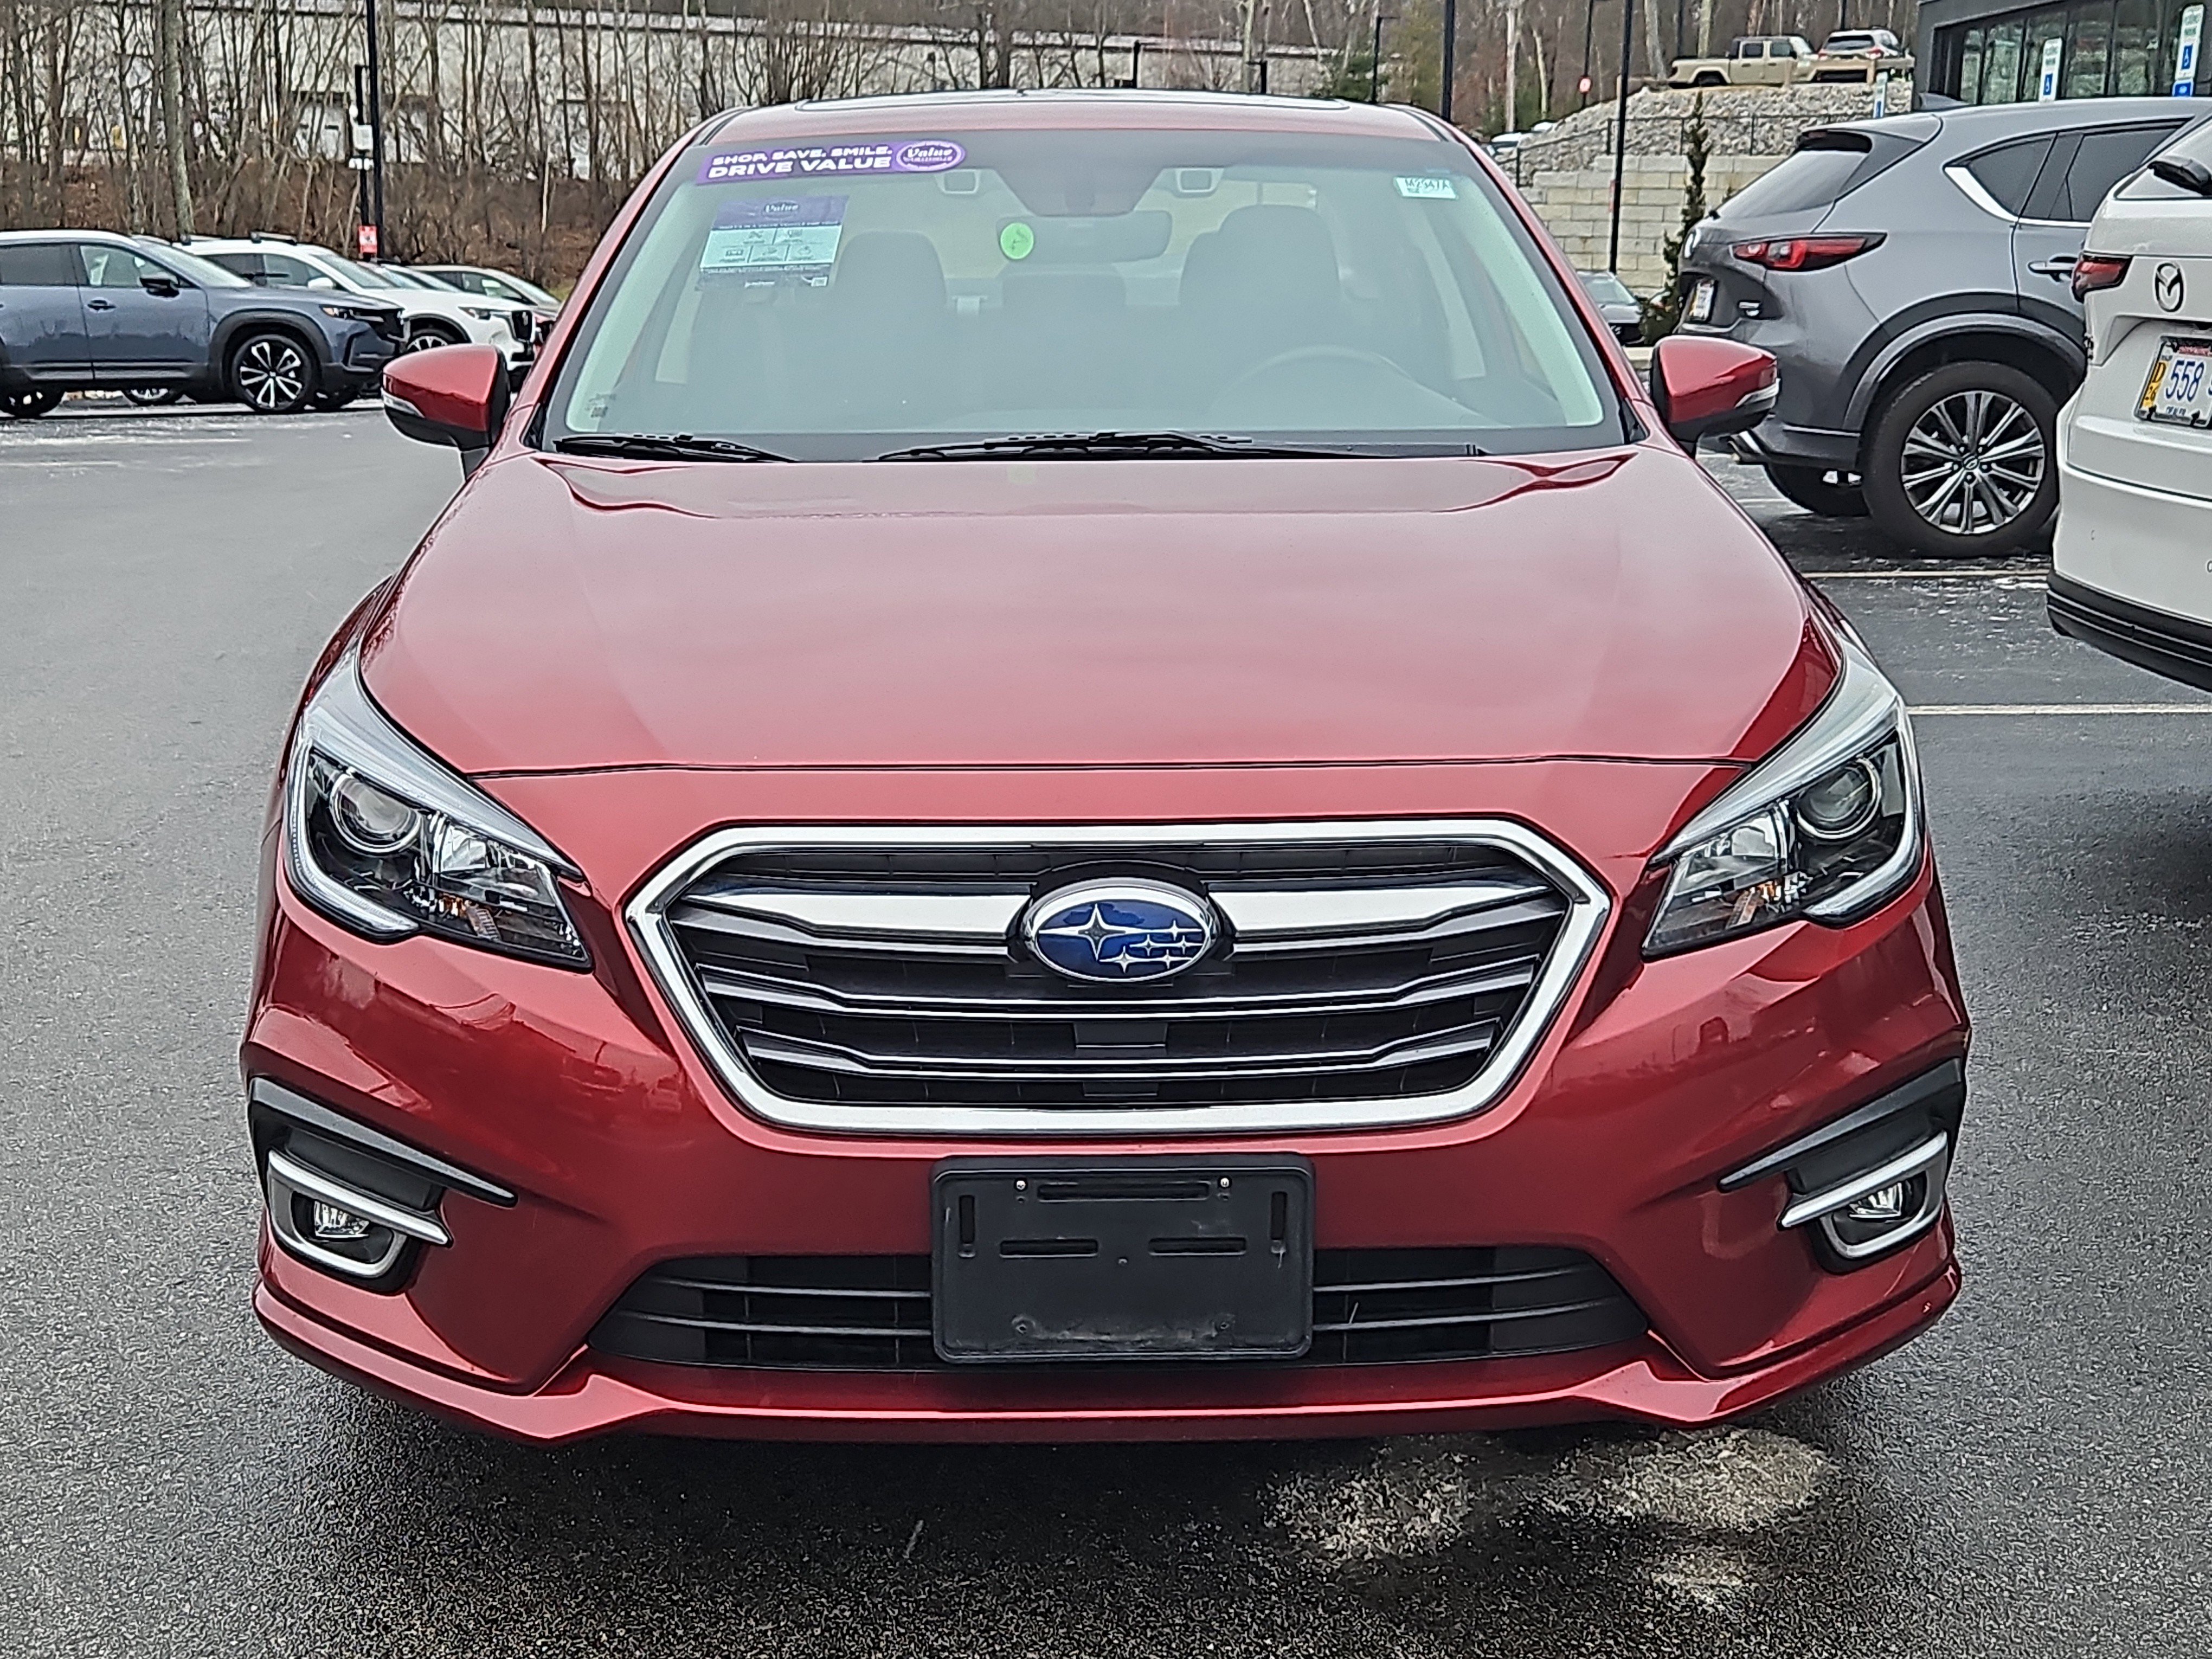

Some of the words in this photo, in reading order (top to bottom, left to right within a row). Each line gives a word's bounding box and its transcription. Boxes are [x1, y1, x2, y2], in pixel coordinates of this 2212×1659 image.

[771, 149, 826, 160] SAVE.
[830, 146, 893, 157] SMILE.
[907, 147, 953, 158] Value
[708, 161, 793, 178] DRIVE
[800, 156, 892, 171] VALUE
[2165, 359, 2205, 402] 558
